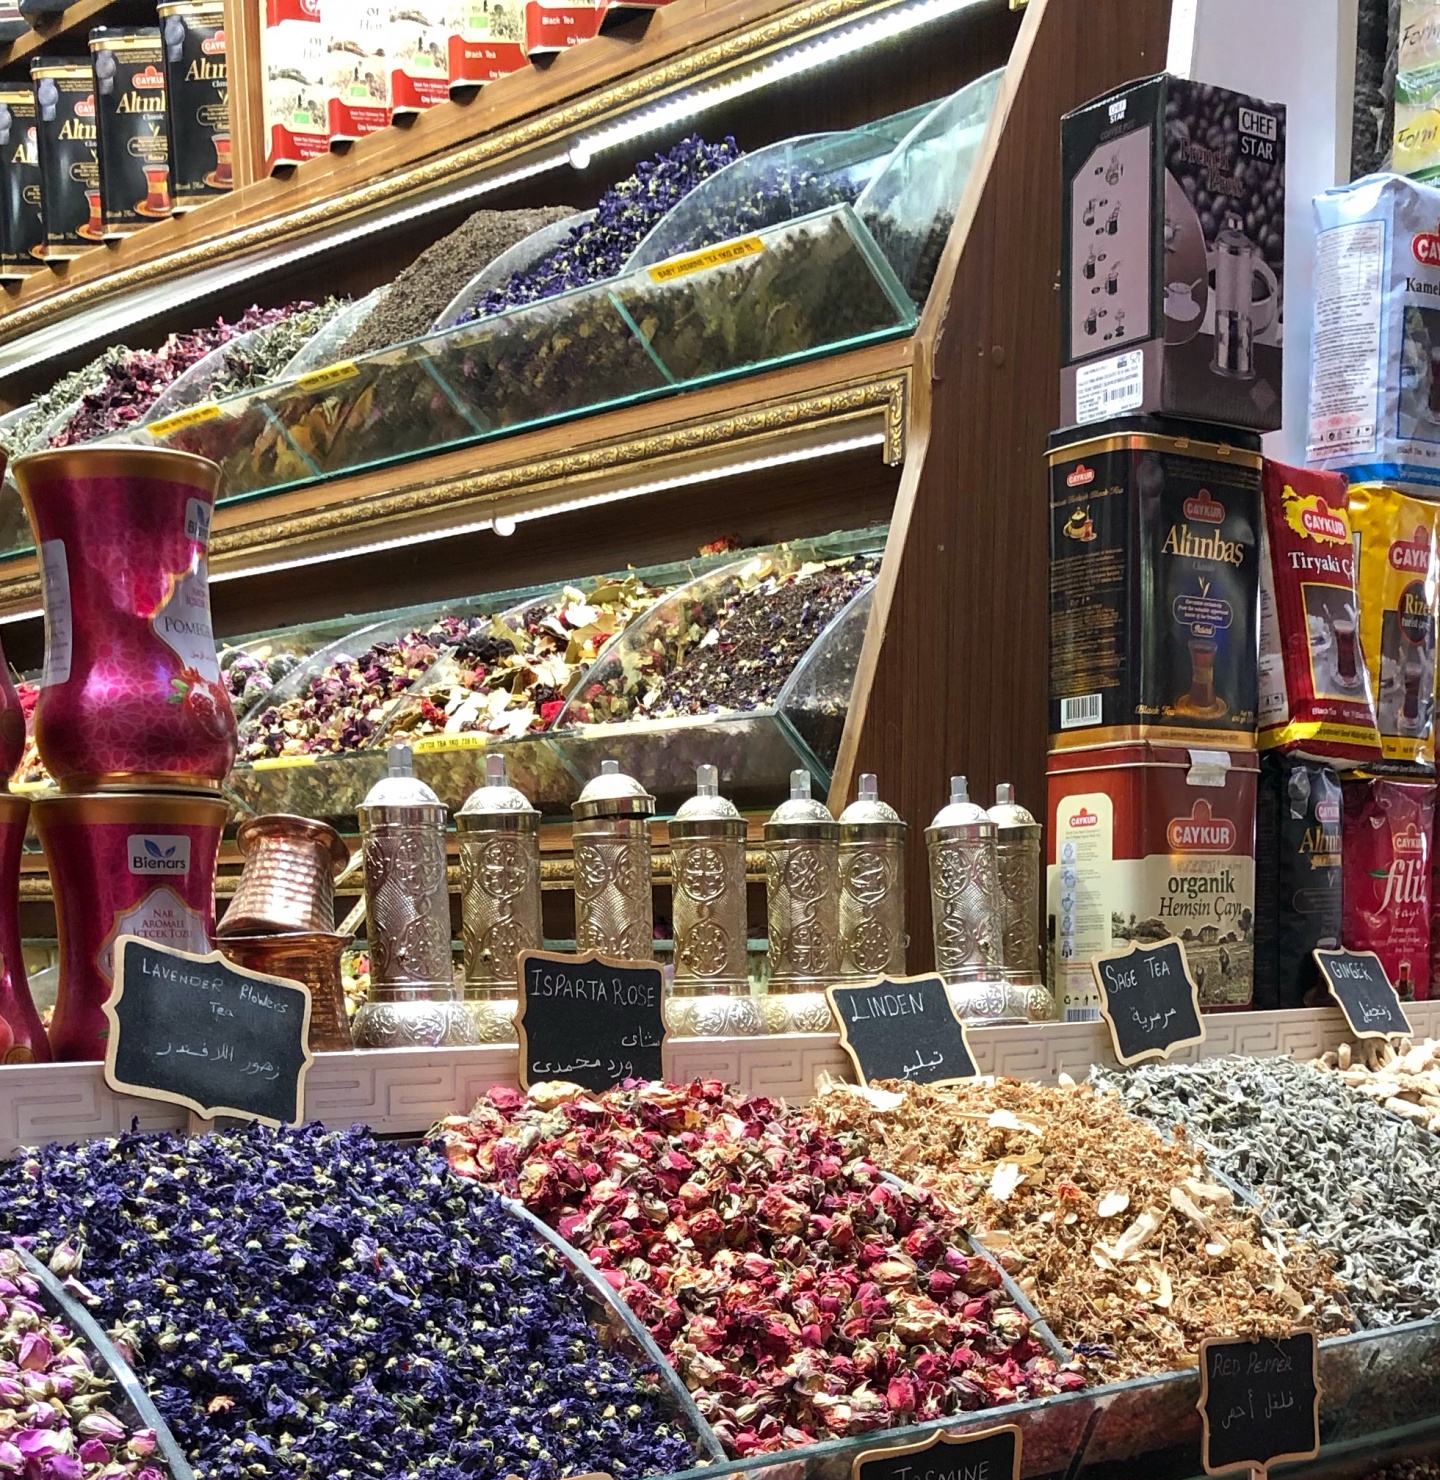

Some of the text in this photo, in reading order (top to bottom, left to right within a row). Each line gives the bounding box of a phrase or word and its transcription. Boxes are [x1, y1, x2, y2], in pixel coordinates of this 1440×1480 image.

[562, 16, 574, 24] Tea
[485, 50, 496, 58] Tea
[1110, 110, 1125, 124] STAR
[1242, 111, 1274, 136] CHEF
[1241, 136, 1273, 160] STAR
[704, 256, 718, 266] TEA
[1161, 524, 1244, 568] Altınbaş
[1288, 552, 1340, 575] Tiryaki
[1405, 593, 1430, 616] Rize
[133, 856, 186, 870] Bienars
[1168, 870, 1234, 898] organik
[1158, 896, 1242, 922] Hemşin Çayı
[142, 919, 184, 928] AROMALI
[142, 958, 224, 992] LAVENDER
[1330, 960, 1372, 982] GINGER
[530, 969, 655, 1007] ISPARTA ROSE
[210, 1001, 234, 1020] Tea
[850, 992, 924, 1022] LINDEN
[1130, 1006, 1176, 1032] مرمرية
[608, 1058, 633, 1080] ورد
[1212, 1352, 1293, 1379] RED PEPPER
[1264, 1390, 1294, 1418] فلفل
